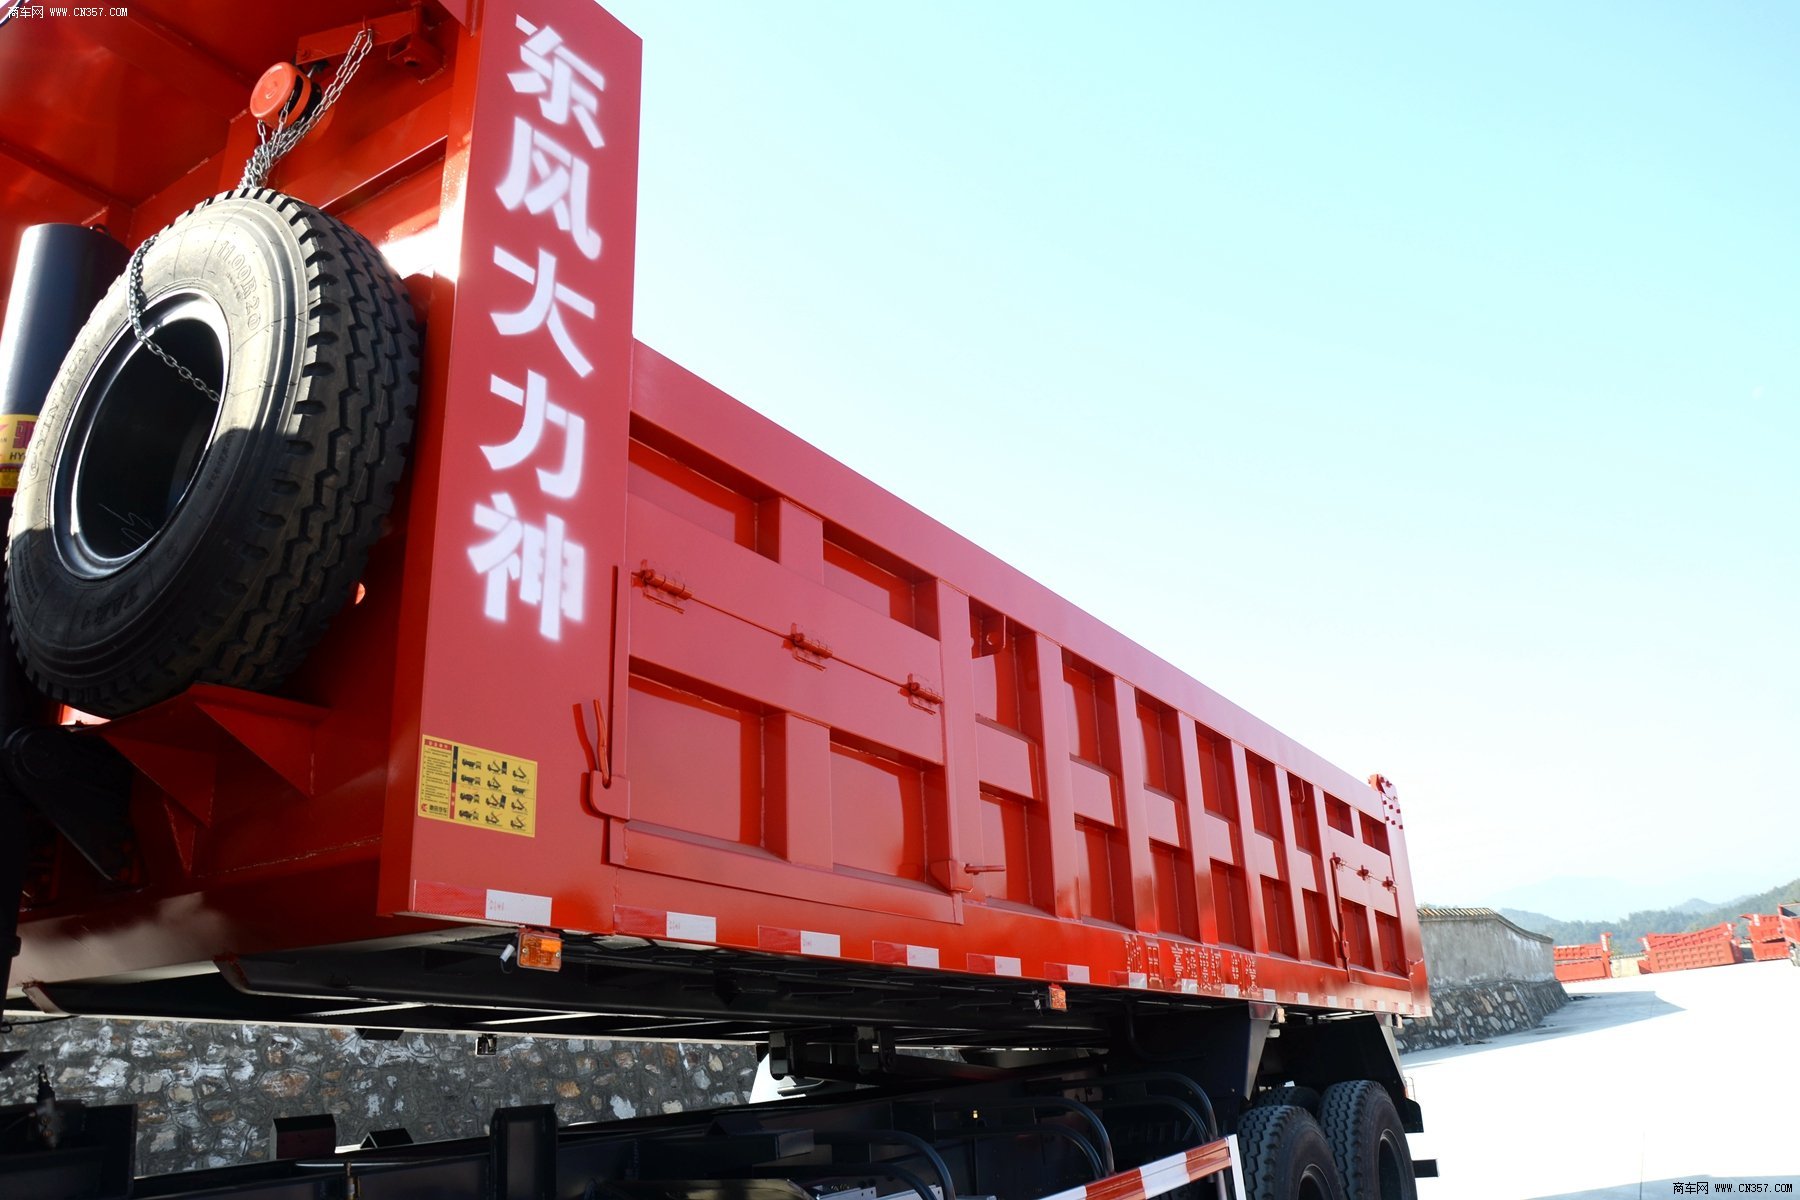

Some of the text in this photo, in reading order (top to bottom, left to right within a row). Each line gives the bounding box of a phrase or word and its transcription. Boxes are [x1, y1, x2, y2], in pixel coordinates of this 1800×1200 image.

[217, 240, 262, 331] 11.00R20
[467, 13, 606, 643] 东风大力神
